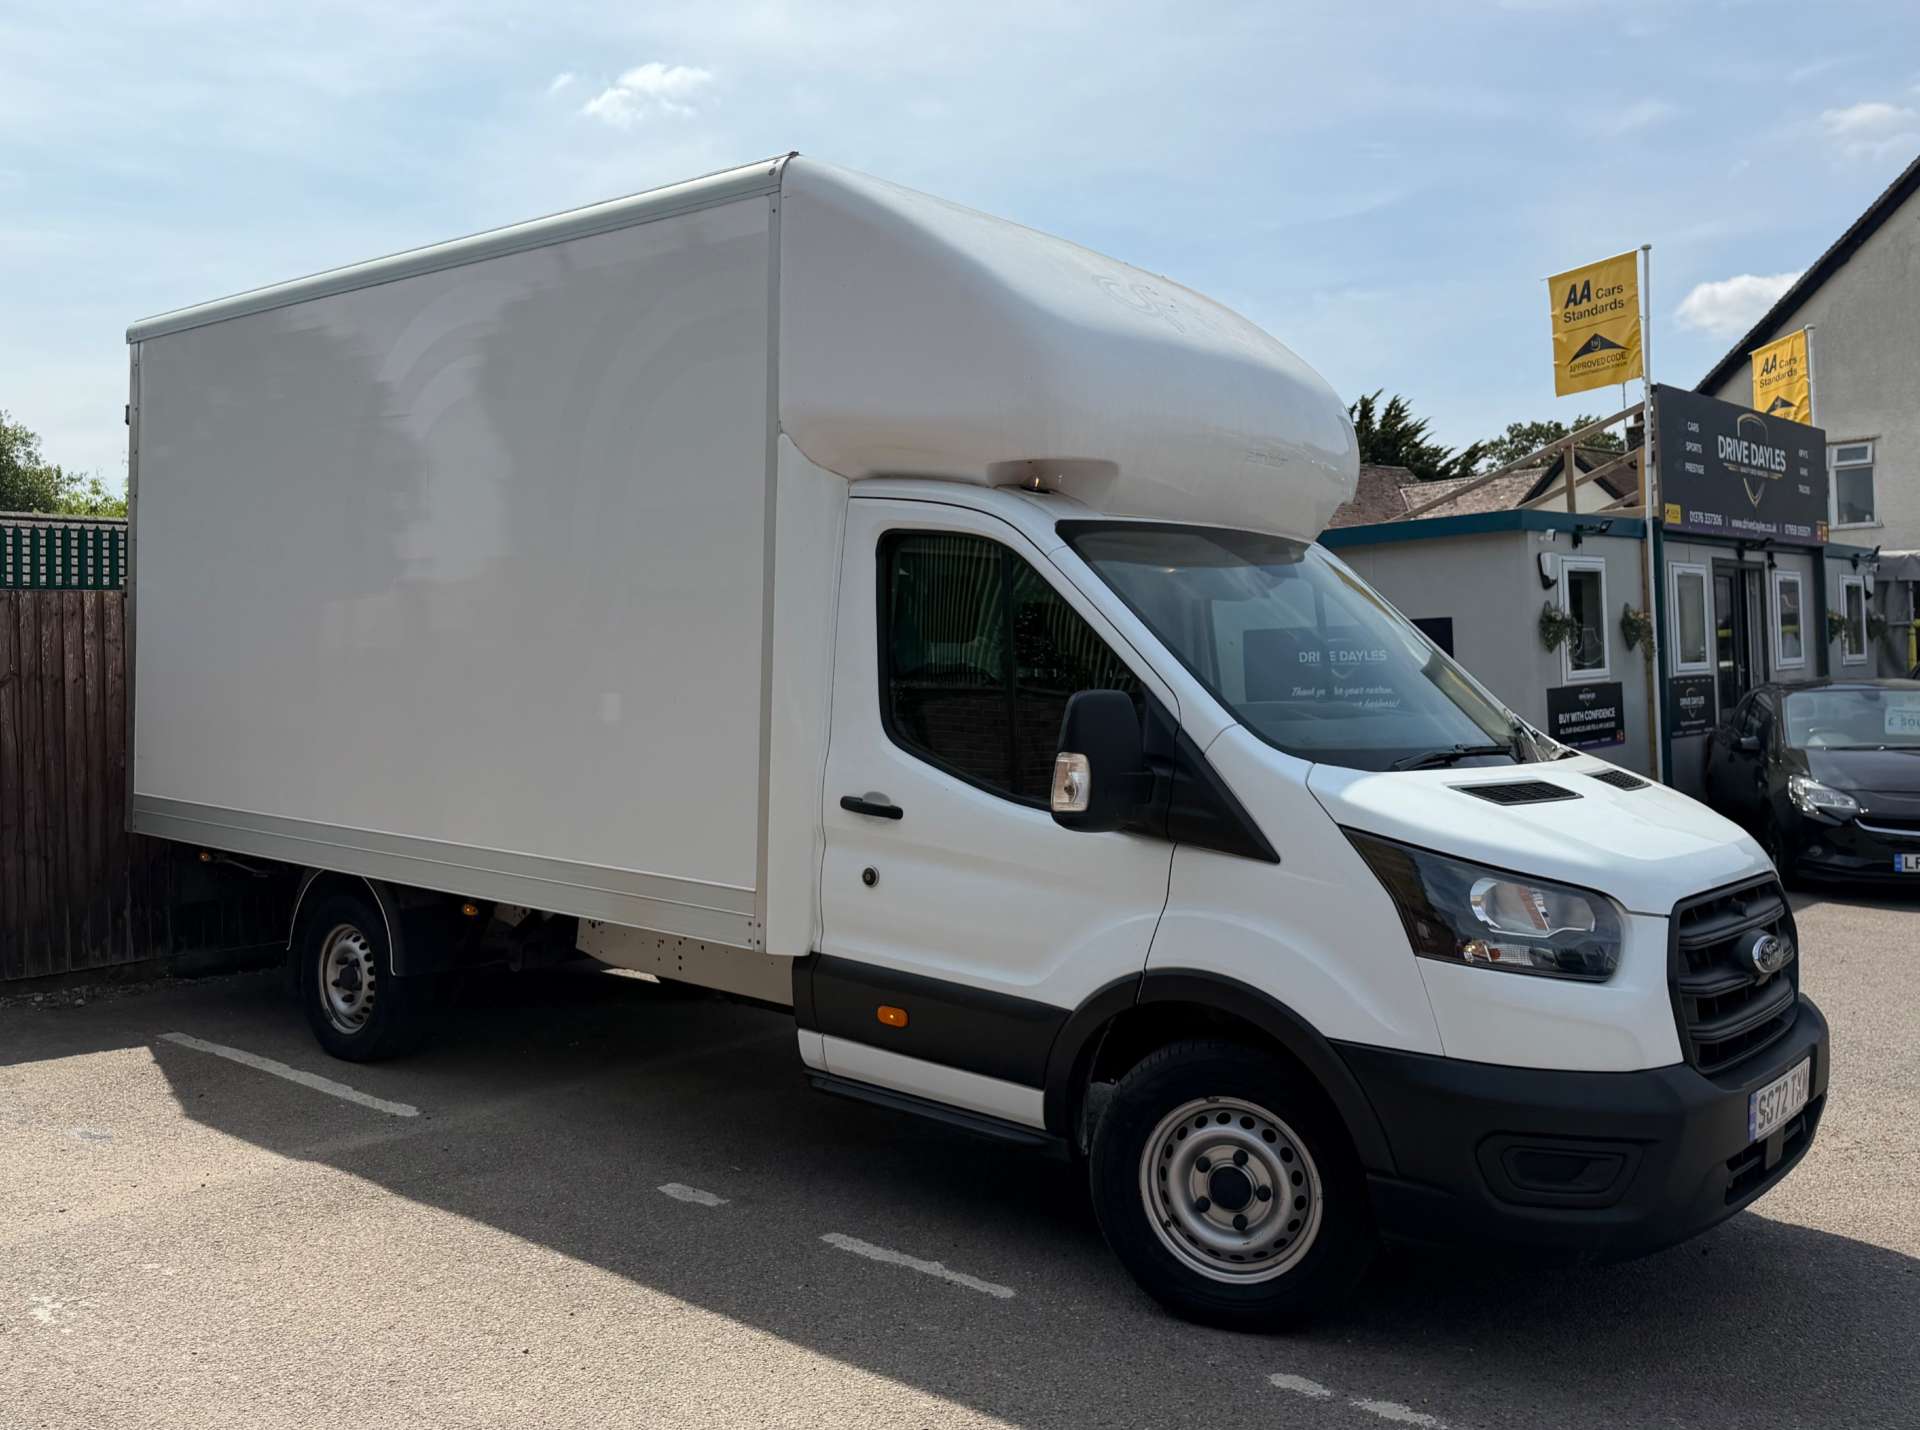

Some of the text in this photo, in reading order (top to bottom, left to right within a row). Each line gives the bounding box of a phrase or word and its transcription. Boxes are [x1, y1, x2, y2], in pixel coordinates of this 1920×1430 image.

[1564, 280, 1623, 309] AA Cars
[1563, 299, 1624, 323] Standards
[1569, 358, 1605, 373] APPROVED
[1606, 351, 1627, 365] CODE
[1761, 353, 1797, 377] AA Cars
[1760, 368, 1798, 388] Standards
[1718, 435, 1786, 472] DRIVE DAYLES
[1299, 649, 1387, 662] DRIE DAYLES
[1559, 707, 1616, 724] BUY WITH CONFIDENCE
